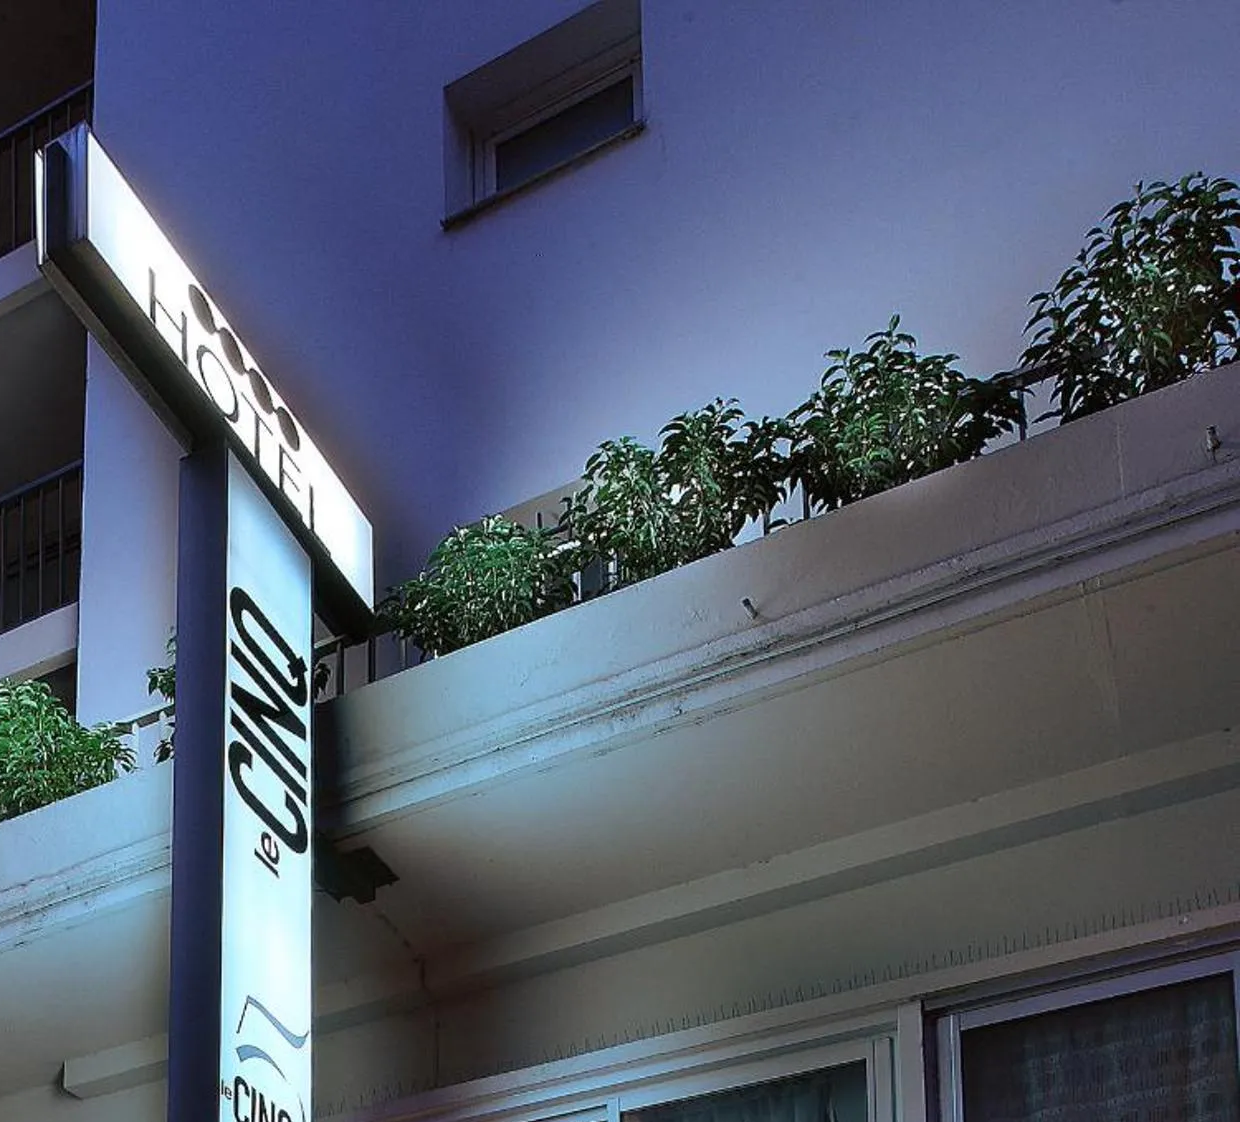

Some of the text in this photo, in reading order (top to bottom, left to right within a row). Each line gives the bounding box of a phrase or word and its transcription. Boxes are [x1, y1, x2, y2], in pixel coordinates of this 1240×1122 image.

[148, 266, 332, 558] HOTEL
[228, 586, 309, 879] le CINQ
